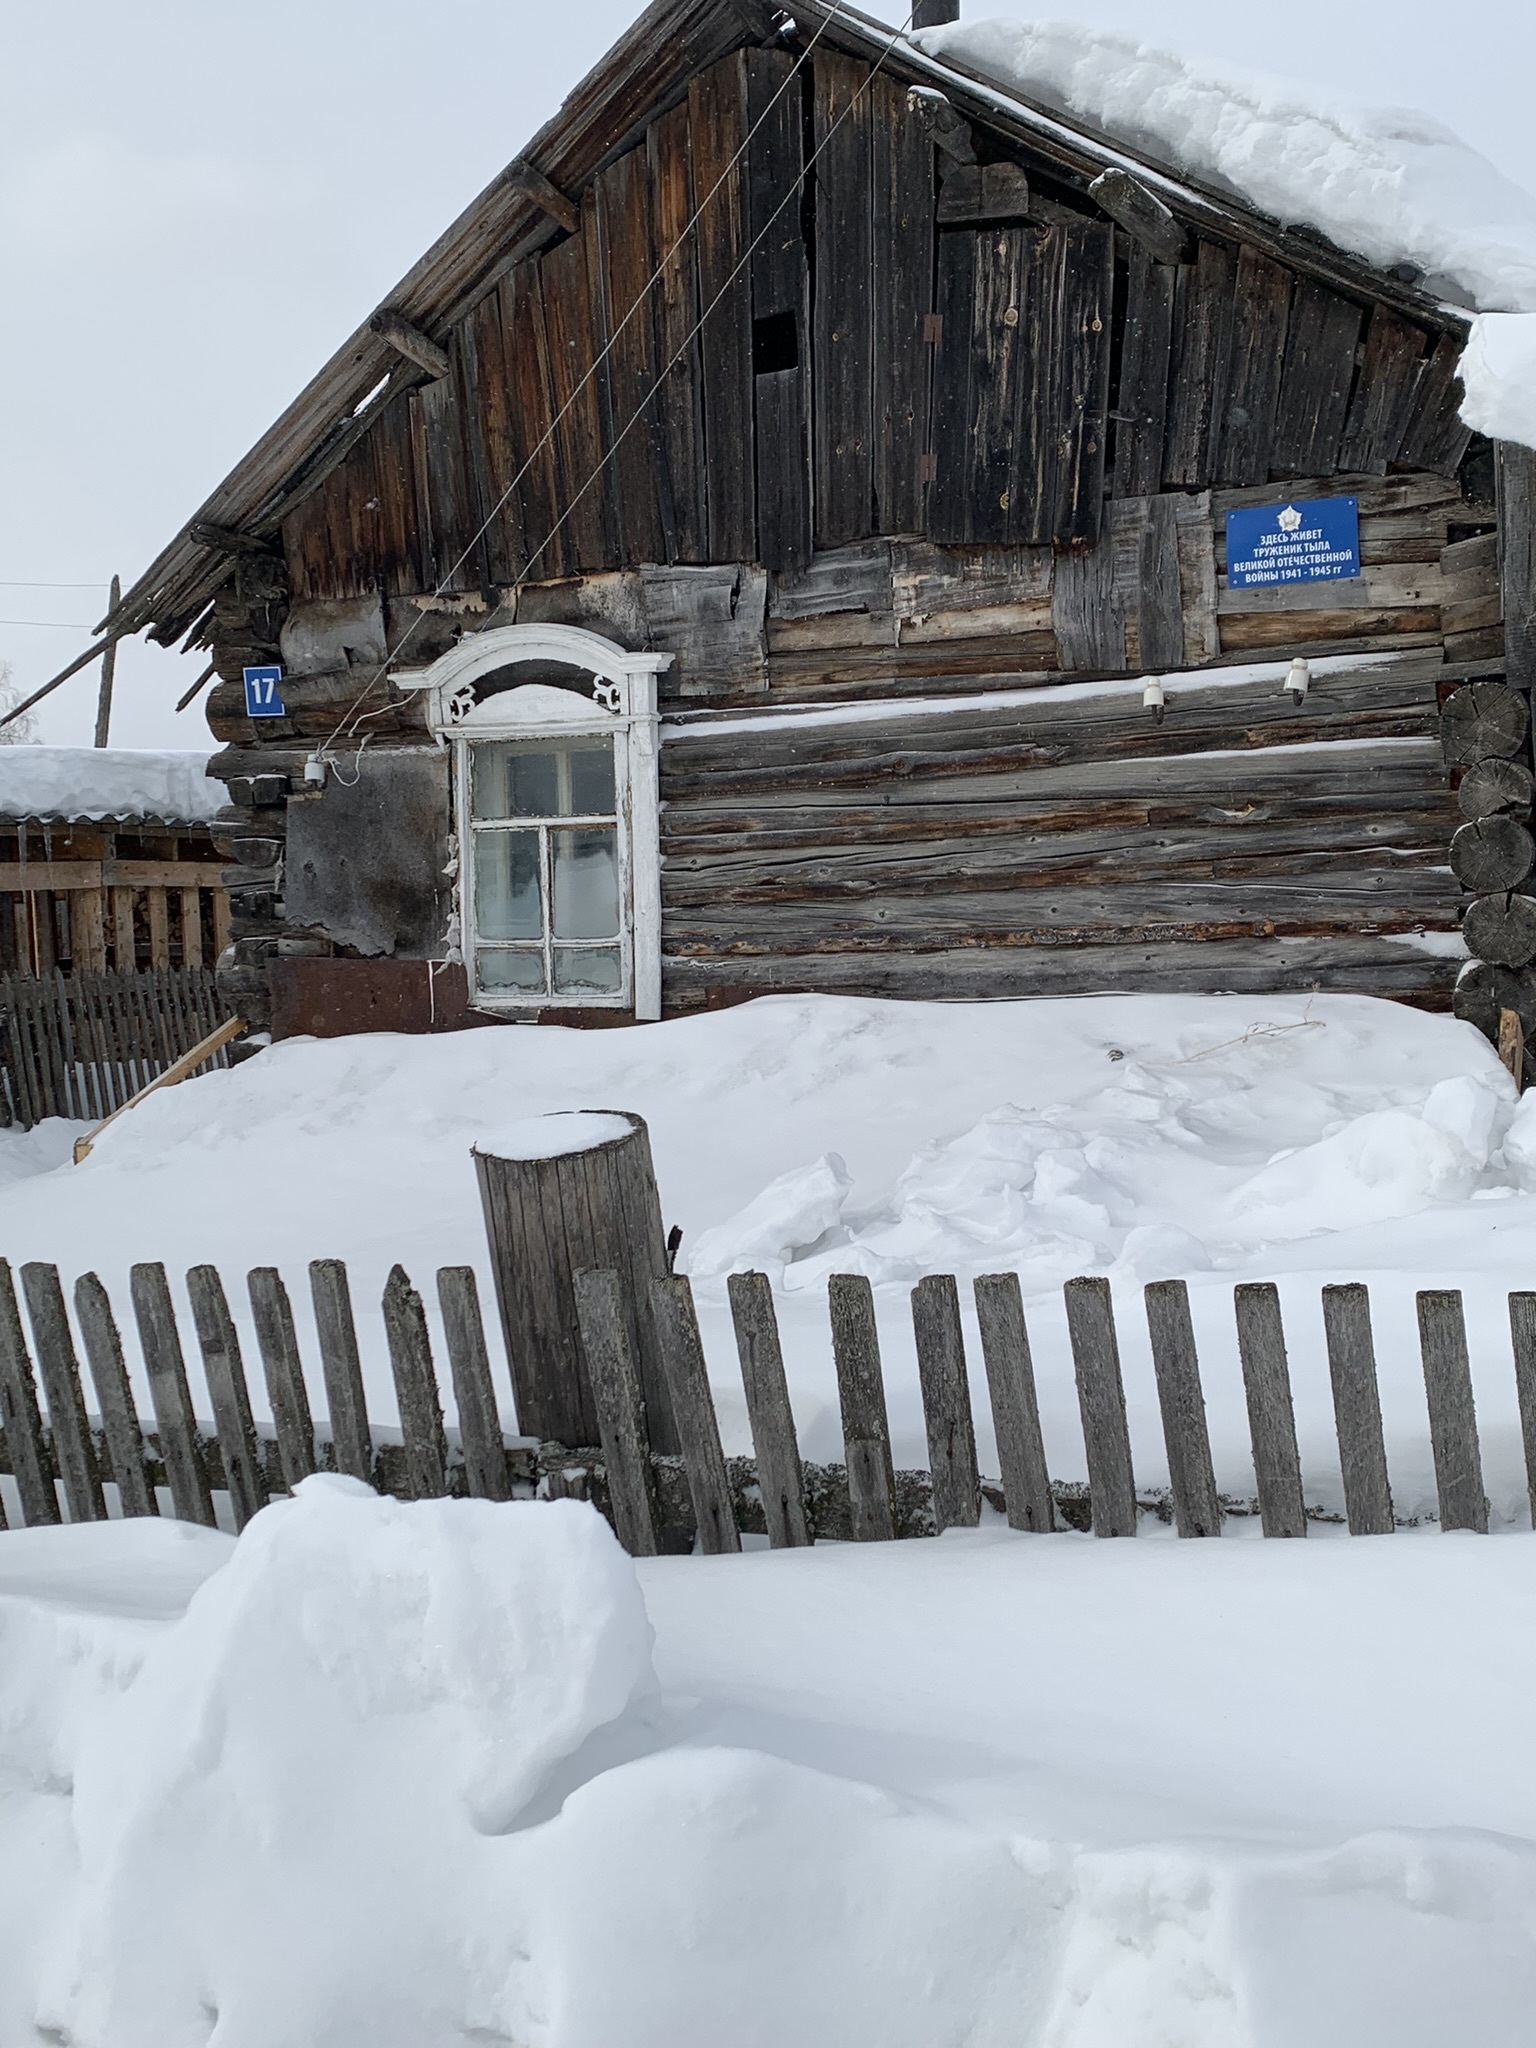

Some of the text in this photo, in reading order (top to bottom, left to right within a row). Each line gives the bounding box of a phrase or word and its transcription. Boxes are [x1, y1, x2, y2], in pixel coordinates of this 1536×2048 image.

[1260, 529, 1323, 546] ЗДЕСЬ ЖИВЕТ
[1253, 541, 1330, 558] ТРУЖЕНИК ТЫЛА
[1234, 549, 1353, 572] ВЕЛИКОЙ ОТЕЧЕСТВЕННОЙ
[1245, 570, 1279, 583] ВОЙНЫ
[1280, 568, 1302, 580] 1941
[1309, 565, 1331, 577] 1945
[251, 678, 275, 704] 17
